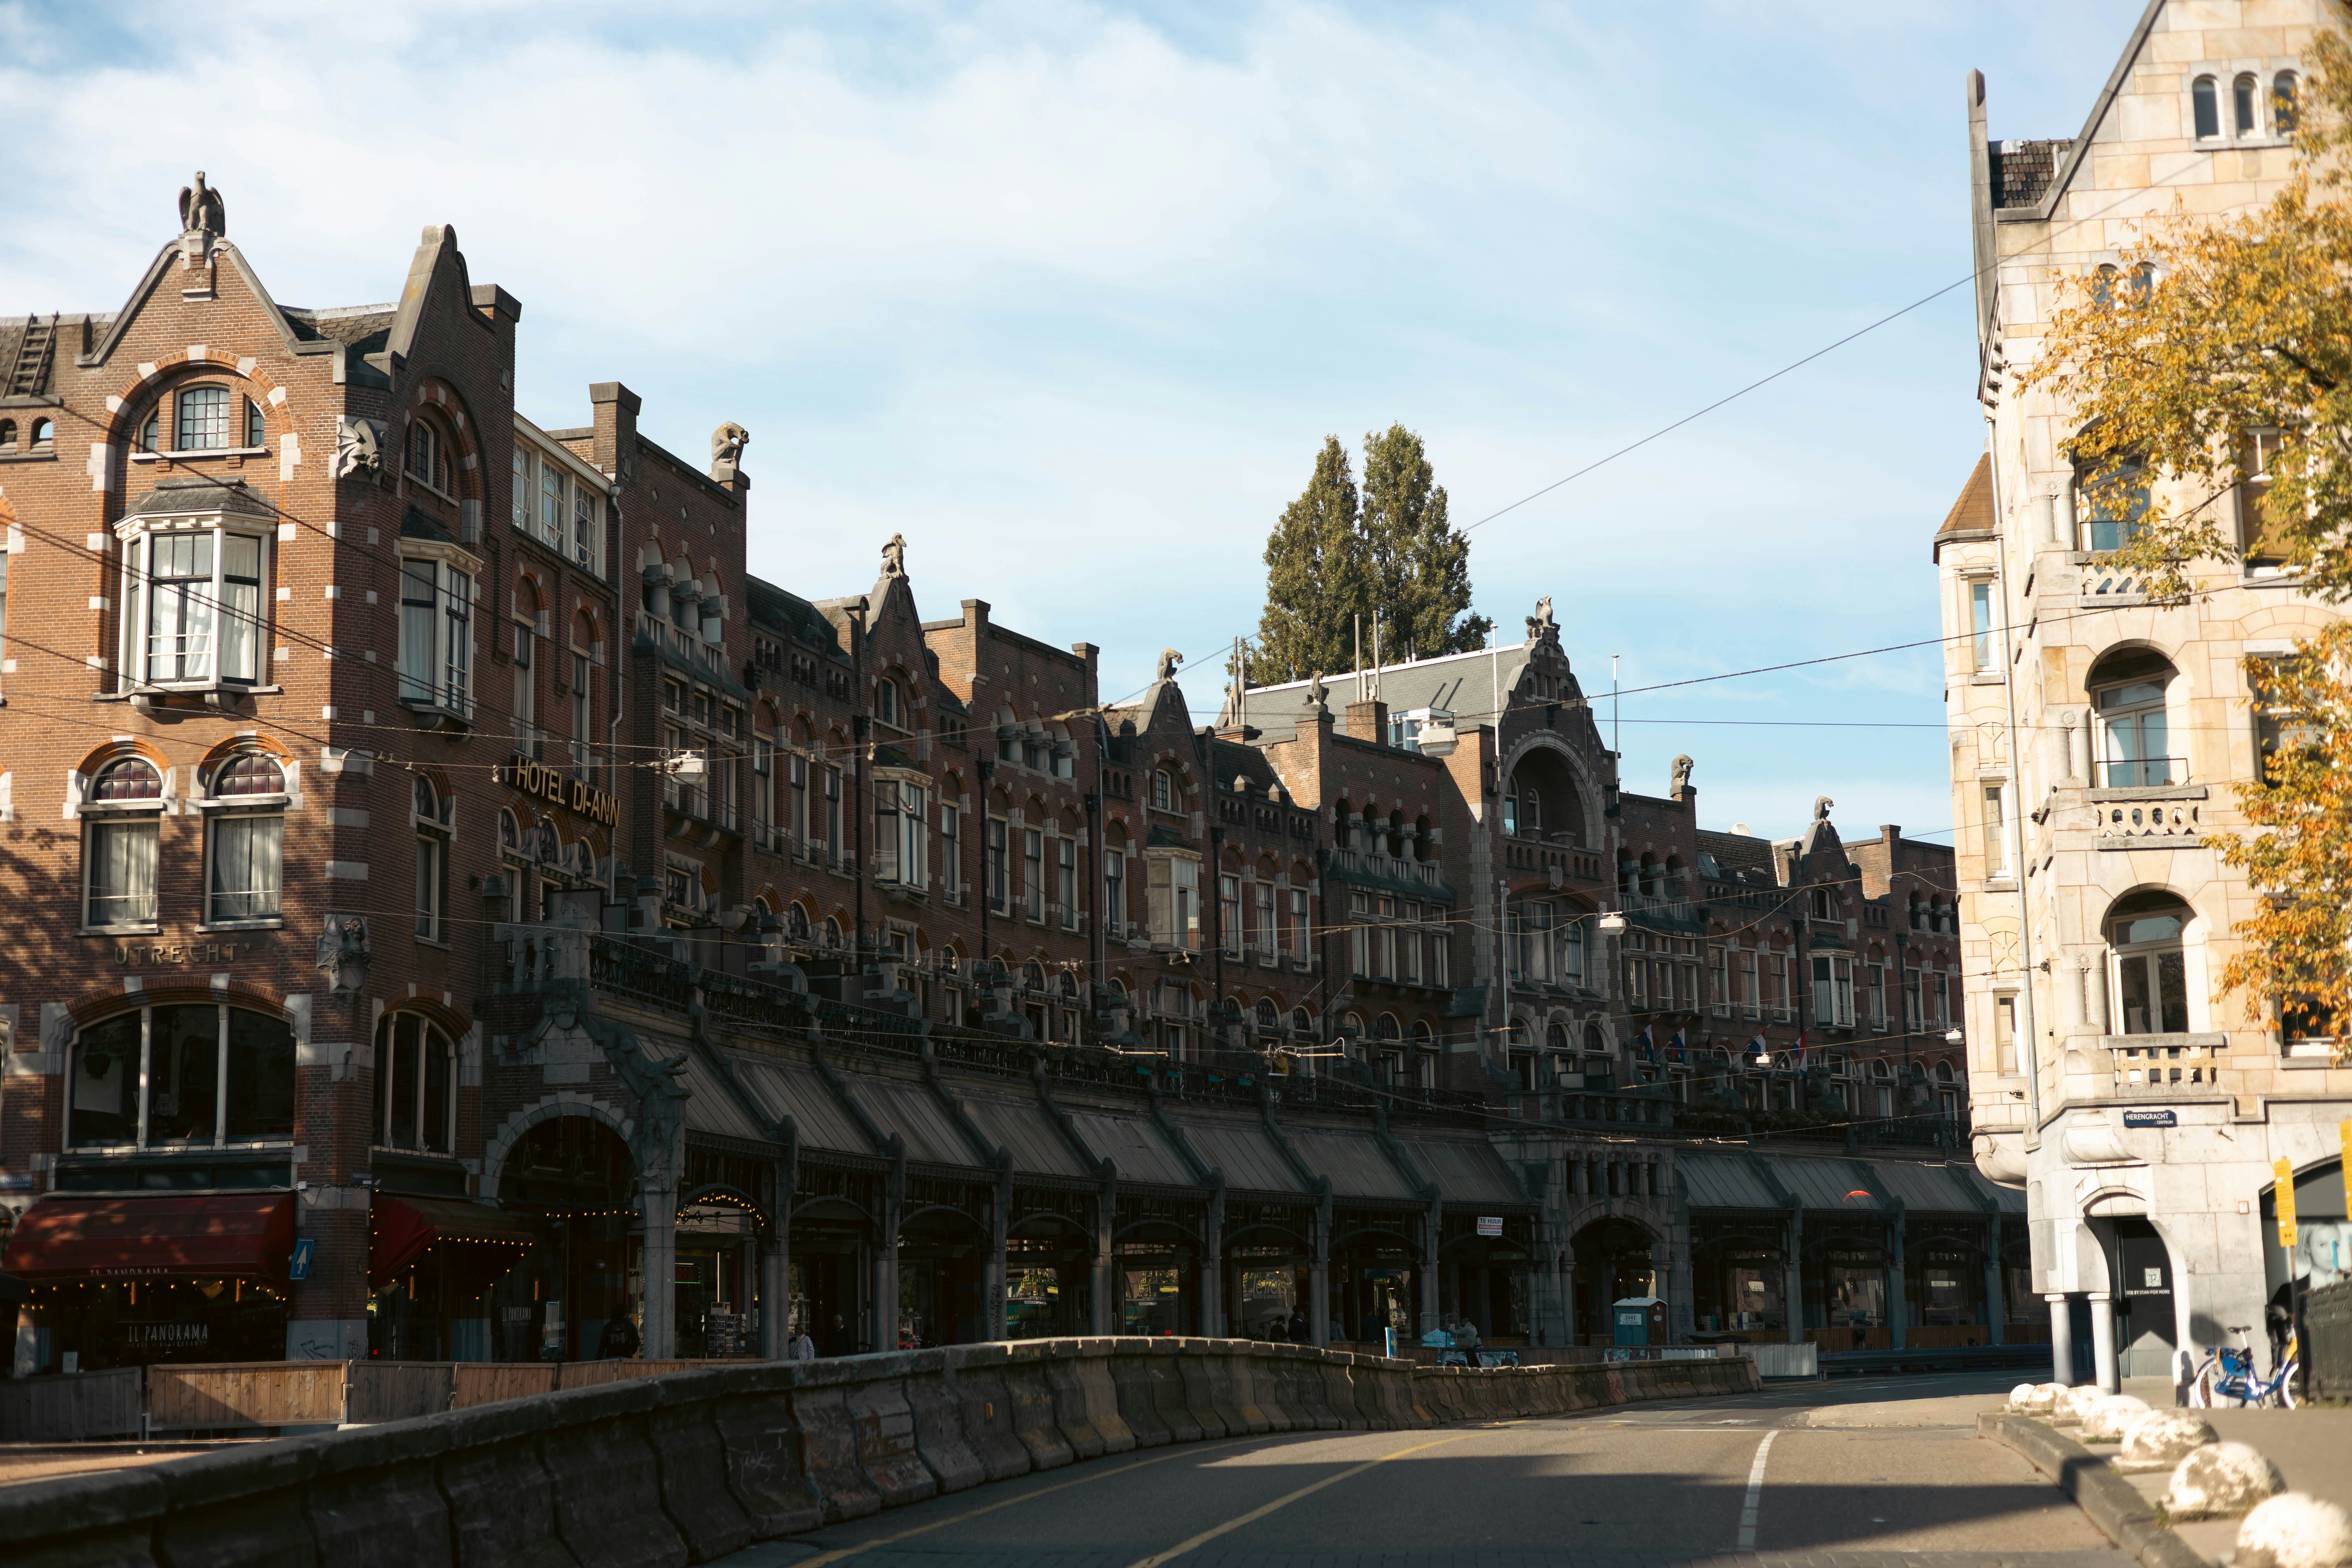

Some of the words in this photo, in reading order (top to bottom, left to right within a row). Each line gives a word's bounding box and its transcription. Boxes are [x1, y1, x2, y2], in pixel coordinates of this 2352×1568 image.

[516, 755, 565, 805] HOTEL
[573, 780, 621, 828] DI-ANN
[128, 1327, 138, 1342] IL
[145, 1324, 209, 1341] PANORAMA
